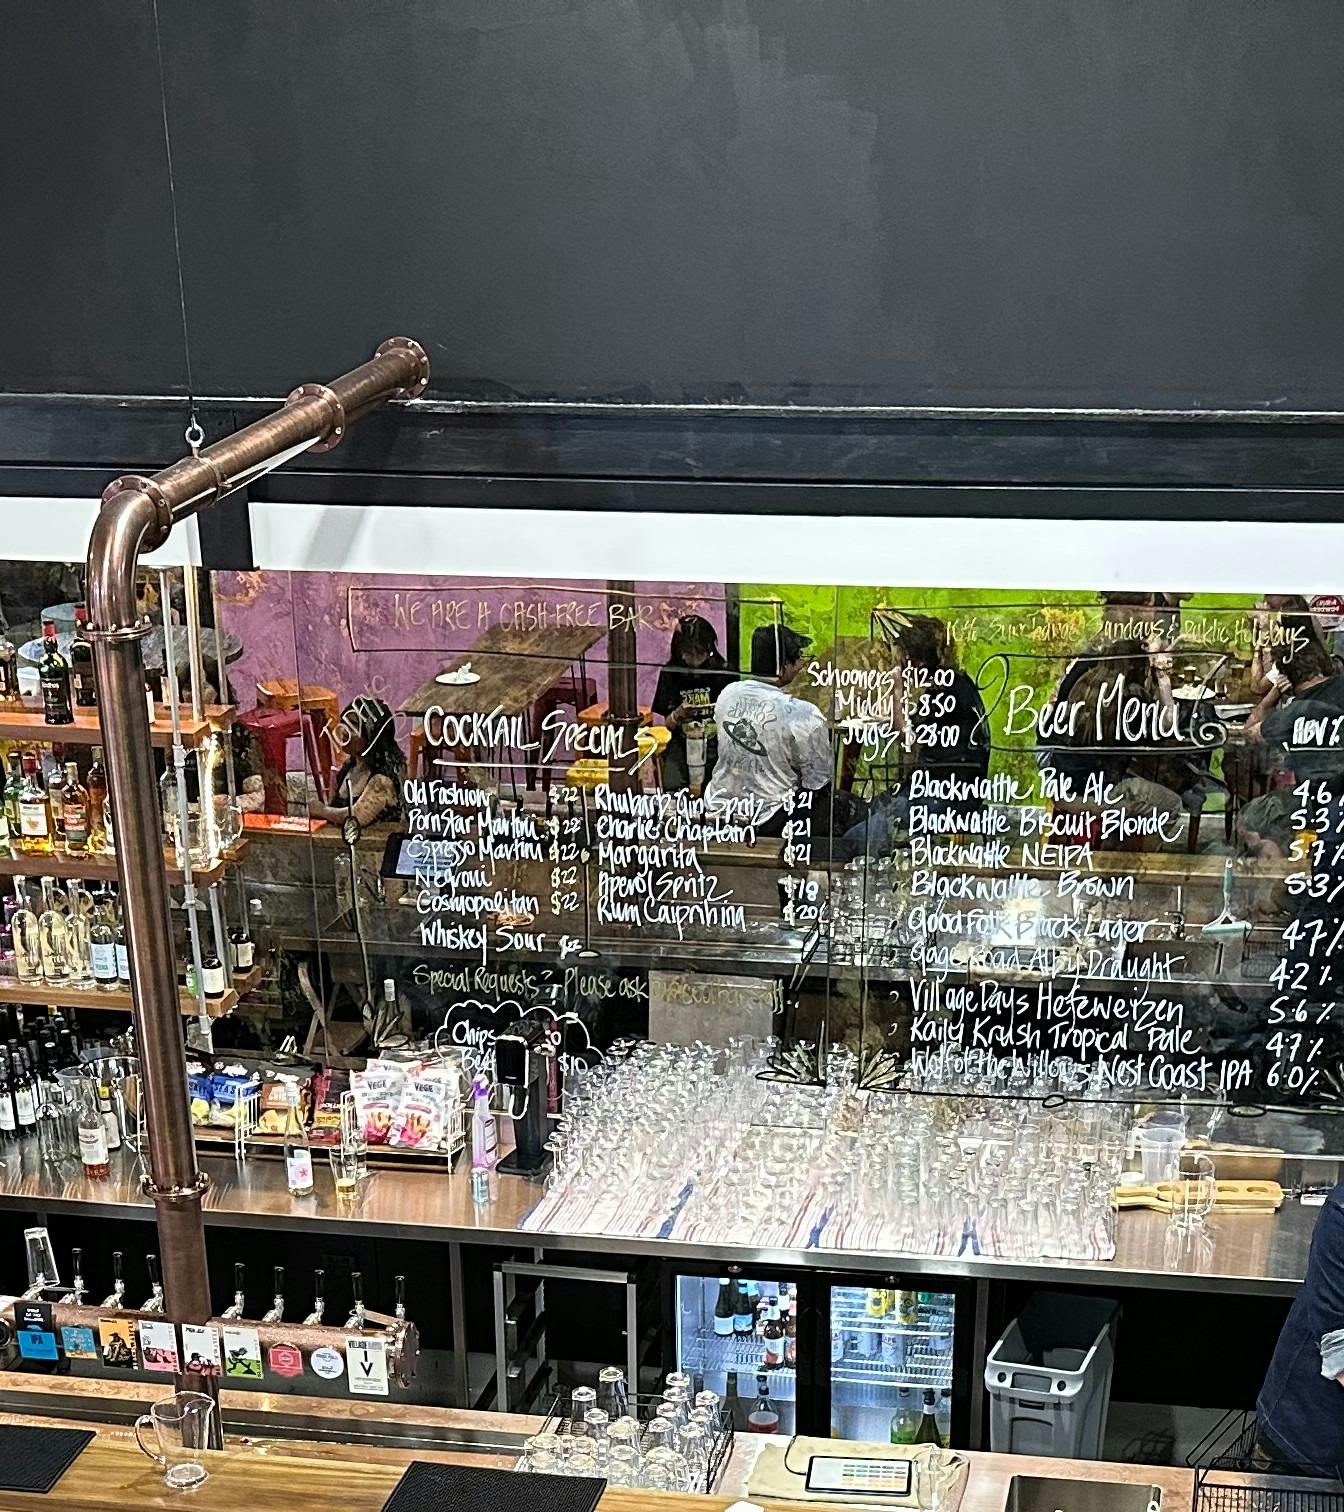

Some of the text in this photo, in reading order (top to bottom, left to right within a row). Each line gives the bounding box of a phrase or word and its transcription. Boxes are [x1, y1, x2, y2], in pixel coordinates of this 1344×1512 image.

[394, 593, 426, 631] WE
[431, 599, 472, 631] ARE
[477, 600, 491, 631] A
[608, 603, 656, 633] BAR
[807, 661, 902, 698] Schooners
[834, 686, 894, 731] Middy
[1003, 673, 1187, 743] Beer Menu
[423, 704, 659, 776] COCKTAIL SPECIALS
[908, 770, 1034, 802] Blackwattle
[1038, 767, 1077, 804] Pale
[1083, 771, 1124, 805] Ale
[908, 805, 1011, 837] Blackwattle
[1019, 806, 1099, 840] Biscuit
[1101, 807, 1185, 843] Blonde
[406, 833, 476, 871] Espresso
[598, 840, 704, 878] Margarita
[909, 836, 1011, 869] Blackwattle
[1022, 842, 1094, 872] NEIPA
[415, 865, 493, 898] Negroni
[910, 869, 1042, 901] Blackwattle
[1057, 869, 1135, 900] Brown
[415, 888, 540, 920] Cosmopolitan
[596, 895, 643, 927] Rum
[419, 918, 488, 966] Whiskey
[495, 926, 547, 953] Sour
[1083, 912, 1158, 952] Lager
[413, 965, 470, 996] Special
[564, 966, 616, 998] Please
[619, 975, 650, 1002] ask
[453, 1019, 497, 1052] Chips
[1048, 1021, 1129, 1062] Tropical
[1148, 1025, 1202, 1055] Pale
[367, 1079, 387, 1091] VEGE
[414, 1082, 435, 1093] VEGE
[1149, 1055, 1214, 1091] Coast
[1219, 1058, 1254, 1091] IPA
